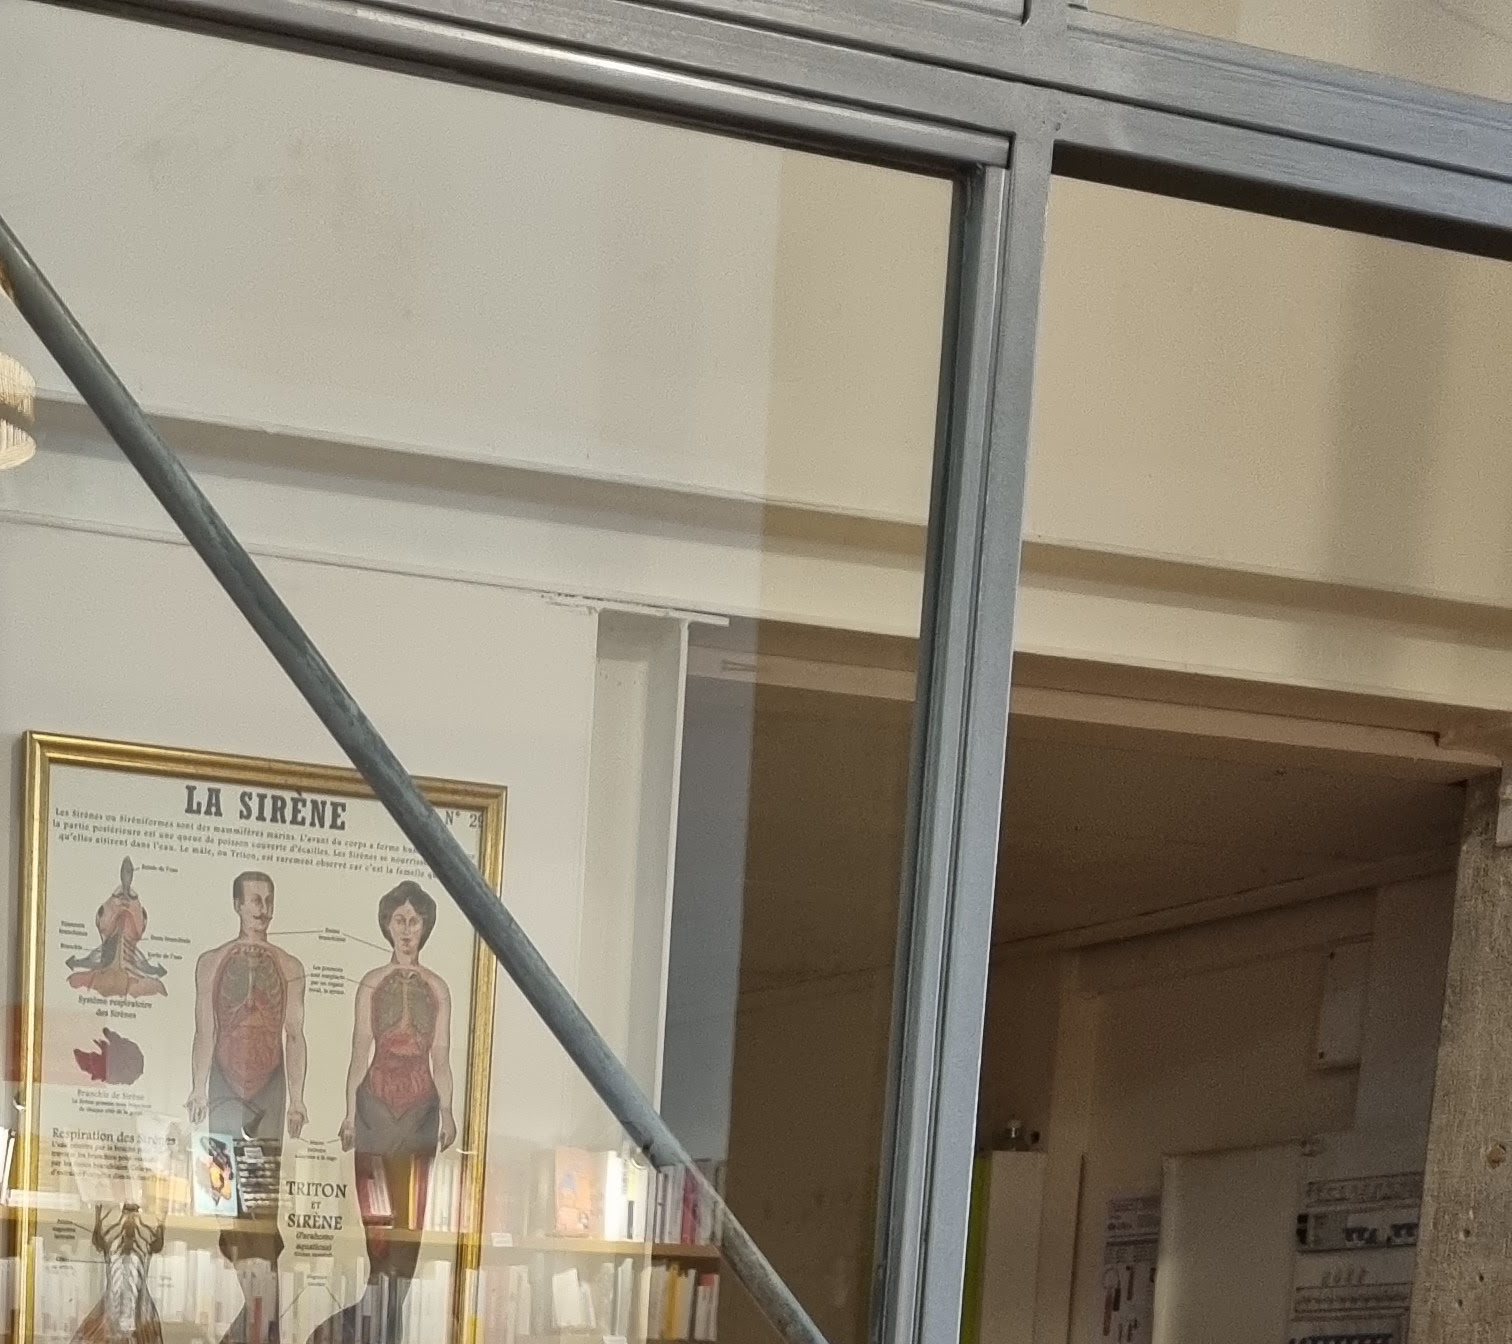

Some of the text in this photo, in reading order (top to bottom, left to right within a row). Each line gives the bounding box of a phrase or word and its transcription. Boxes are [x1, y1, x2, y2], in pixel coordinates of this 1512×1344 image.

[184, 784, 346, 831] LA SIRÈNE
[116, 1131, 134, 1144] des
[286, 1181, 347, 1198] TRITON
[311, 1201, 321, 1210] ET
[288, 1211, 342, 1230] SIRÈNE
